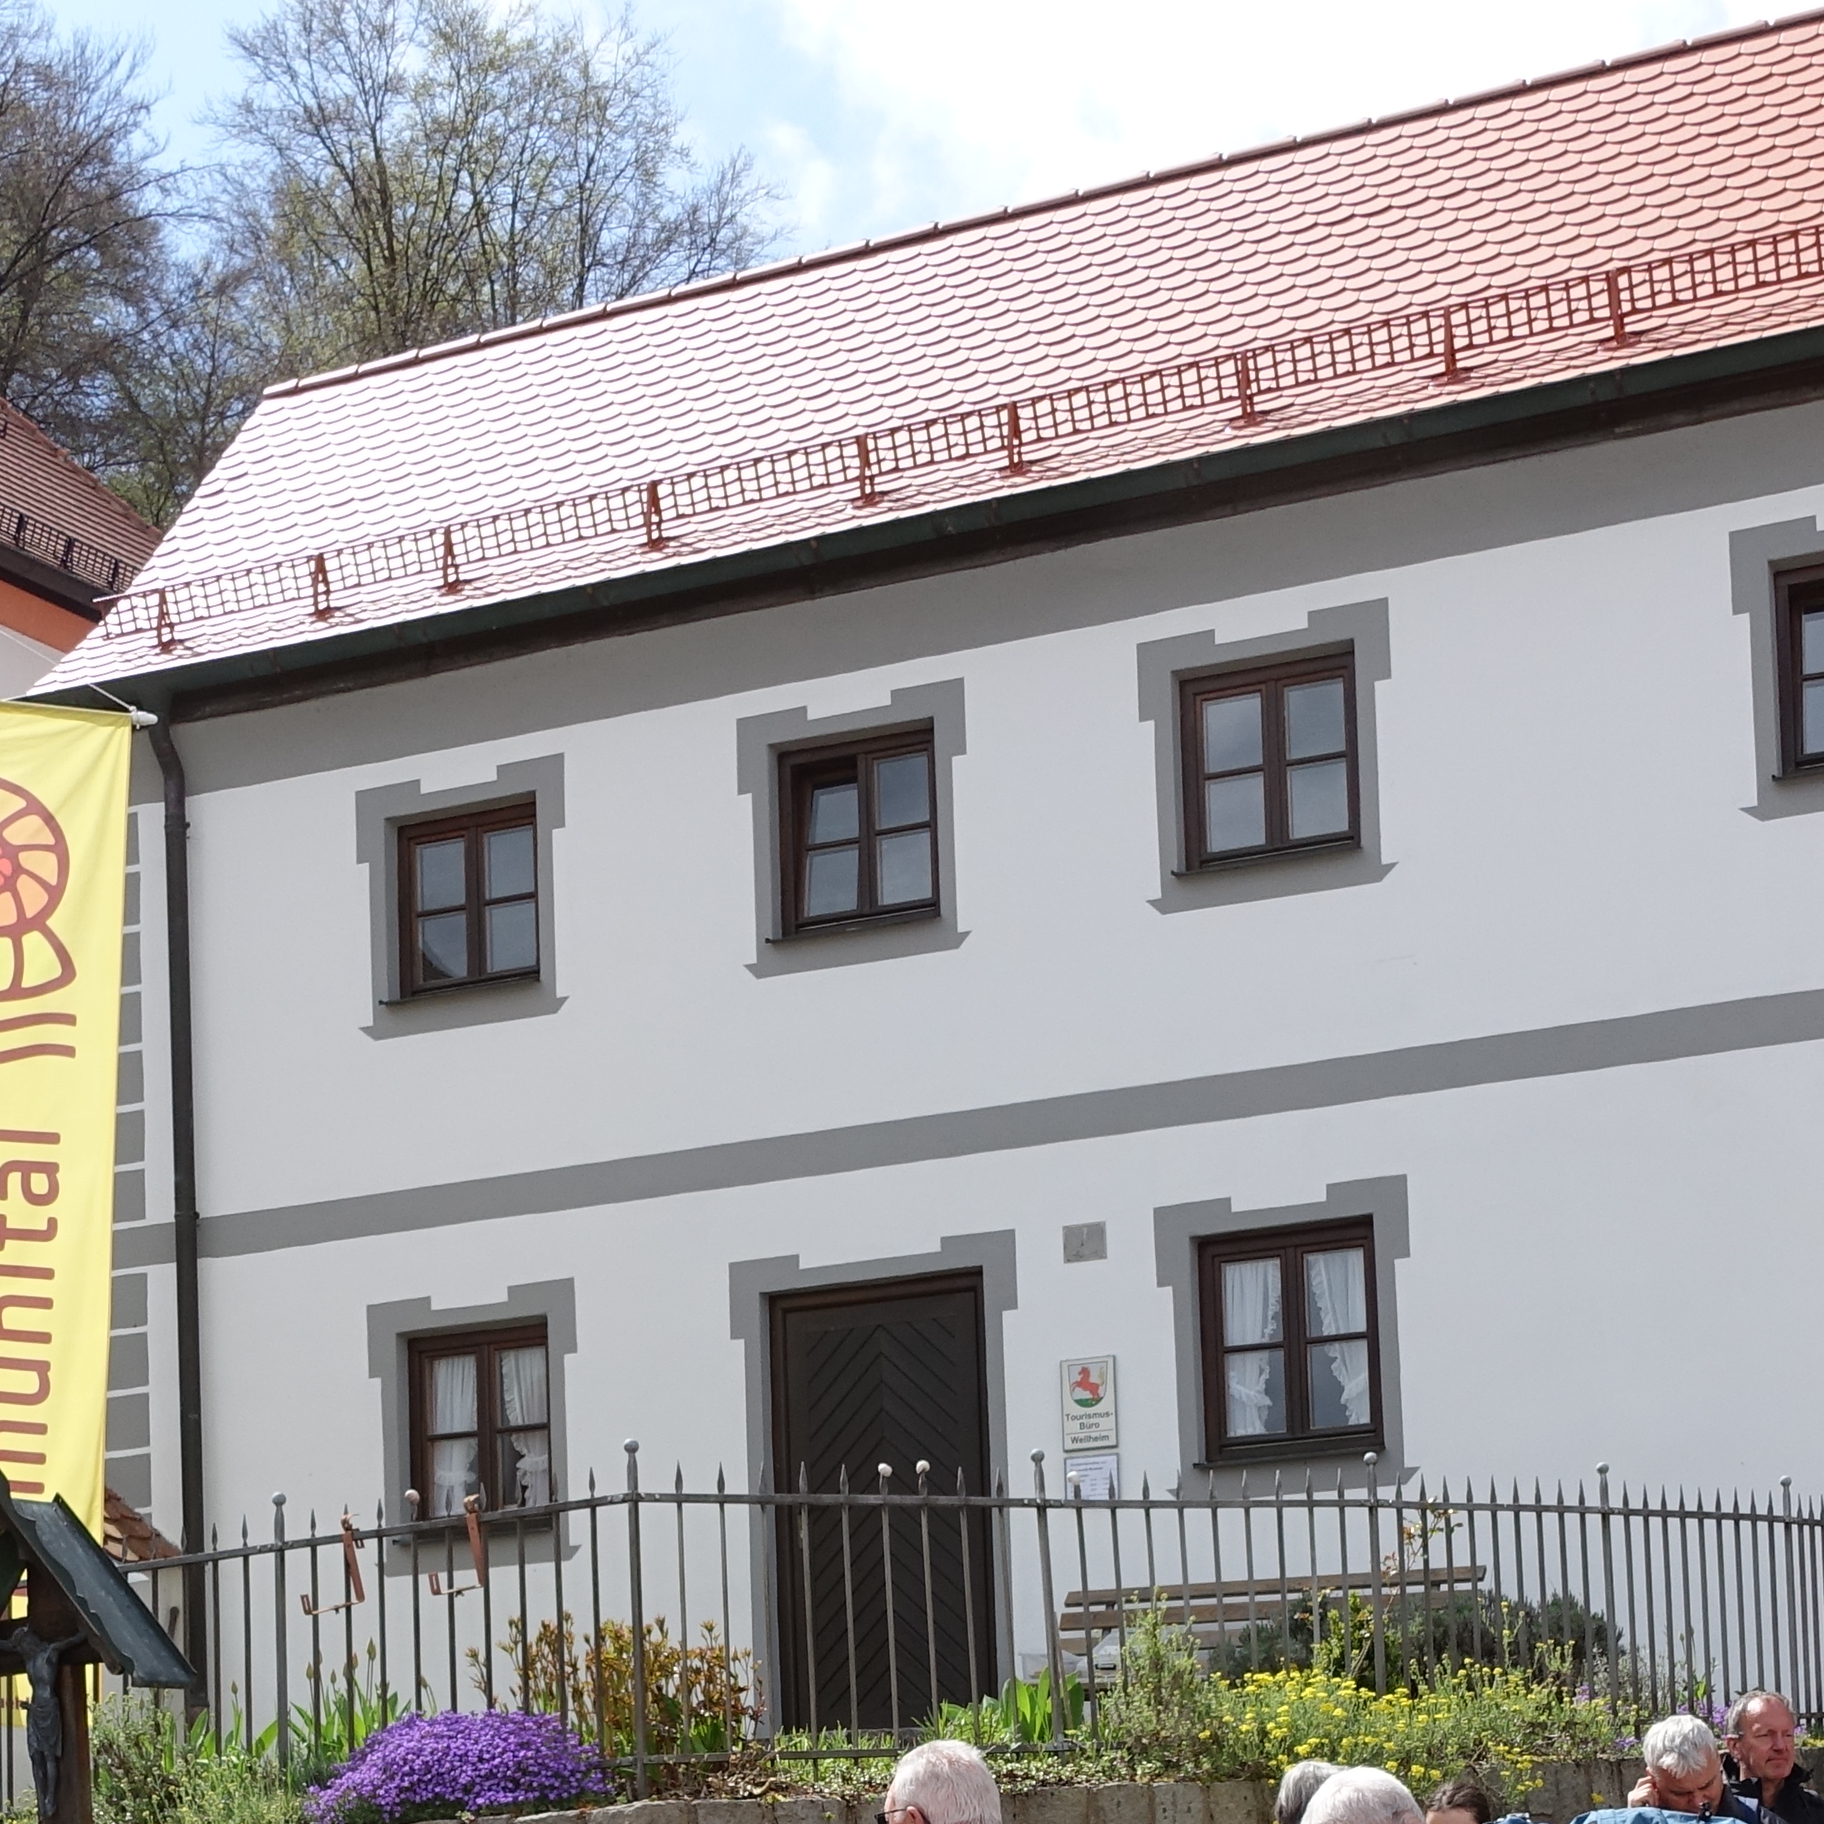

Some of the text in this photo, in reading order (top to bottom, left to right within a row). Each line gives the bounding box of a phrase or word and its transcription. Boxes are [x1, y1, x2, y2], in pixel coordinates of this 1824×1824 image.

[1065, 1410, 1114, 1422] Tourismus-
[1079, 1421, 1100, 1430] Büro
[1070, 1434, 1110, 1445] Wellheim
